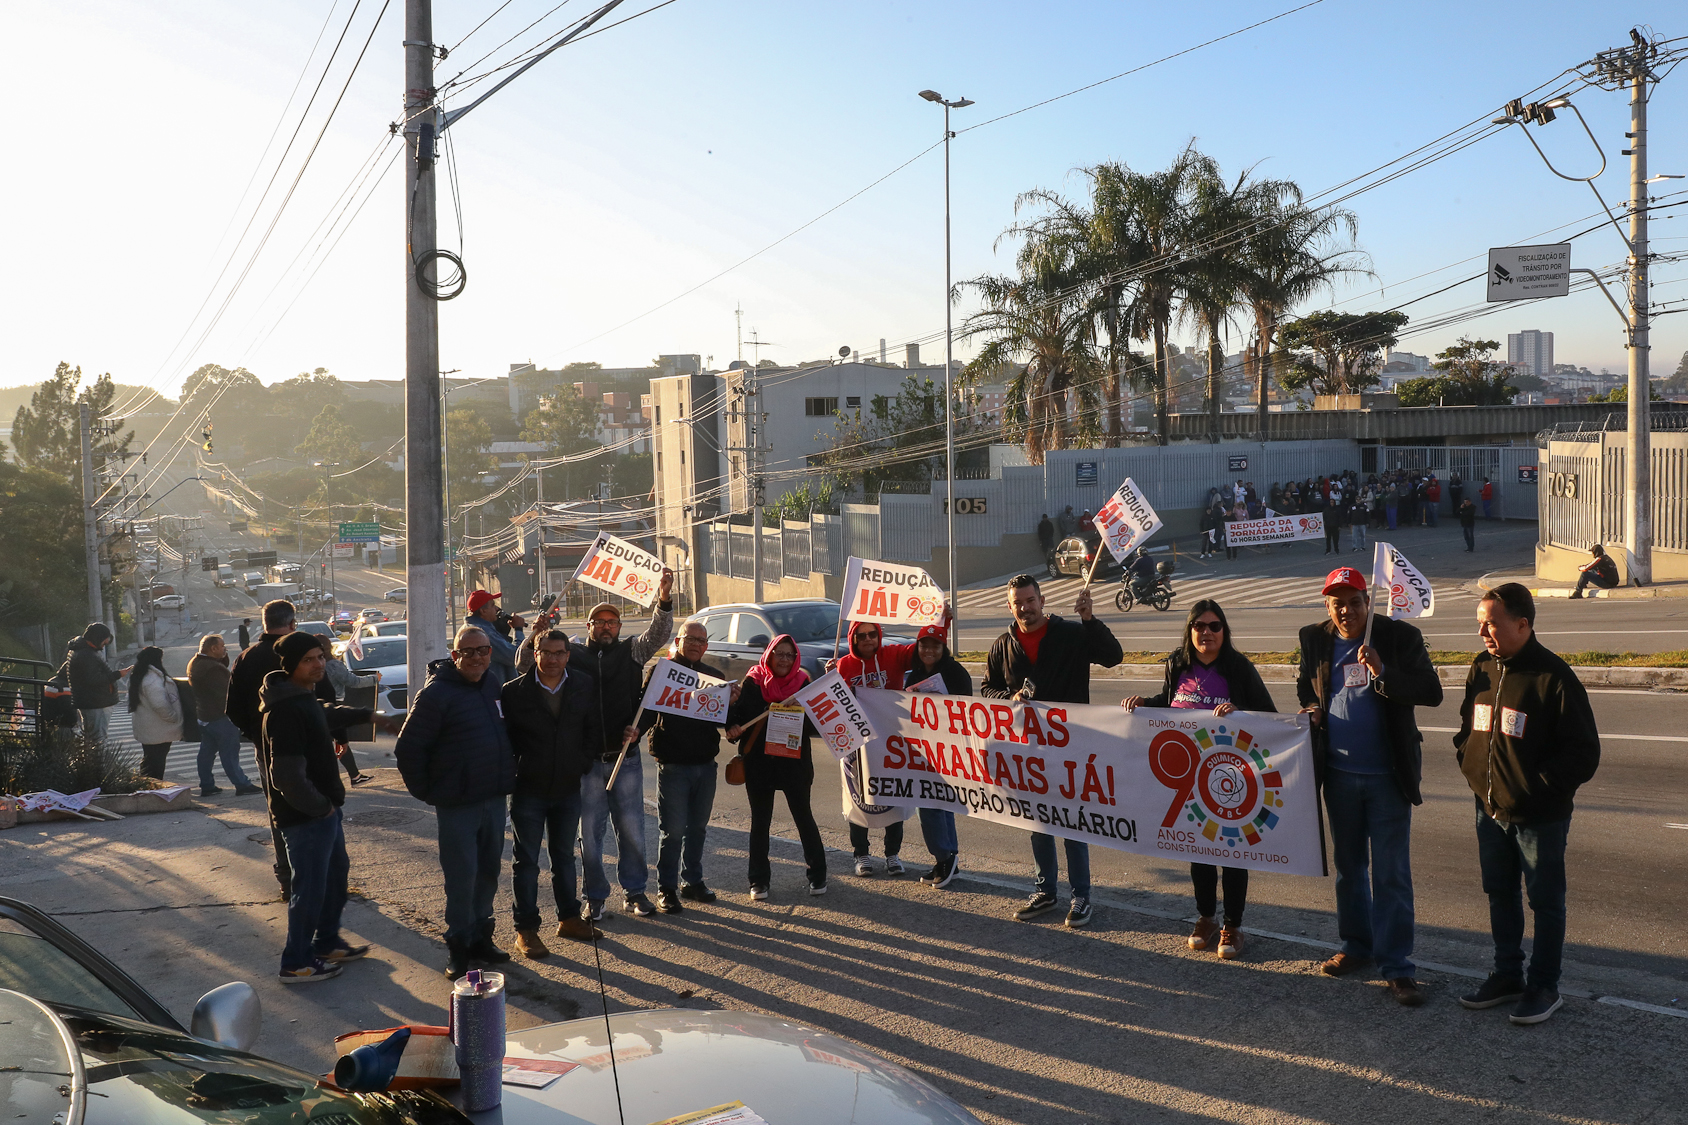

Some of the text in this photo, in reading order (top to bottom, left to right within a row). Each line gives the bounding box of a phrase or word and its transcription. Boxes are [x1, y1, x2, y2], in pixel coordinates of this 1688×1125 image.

[1518, 252, 1567, 262] FISCALIZAÇÃO DE
[1522, 263, 1562, 272] TRÂNSITO POR
[1515, 273, 1567, 283] VIDEOMONITORAMENTO
[1548, 472, 1576, 498] 705
[1119, 484, 1153, 532] REDUÇÃO
[1230, 519, 1276, 530] REDUÇÃO
[1230, 524, 1294, 537] JORNADA JÁ!
[1262, 532, 1295, 541] SEMANAIS
[596, 537, 662, 573] REDUÇÃO
[581, 555, 623, 586] JÁ!
[856, 586, 899, 618] JÁ!
[655, 685, 691, 711] JÁ!
[806, 691, 840, 726] JÁ!
[830, 682, 871, 738] REDUÇÃO
[910, 696, 1070, 748] 40 HORAS
[1148, 719, 1198, 730] RUMO AOS
[883, 735, 1049, 795] SEMANAIS
[1059, 753, 1117, 807] JÁ!
[1206, 753, 1247, 772] QUÍMICOS
[1148, 729, 1259, 828] 90
[868, 776, 1138, 843] SEM REDUÇÃO DE SALÁRIO!
[1157, 828, 1196, 844] ANOS
[1157, 841, 1289, 864] CONSTRUINDO O FUTURO
